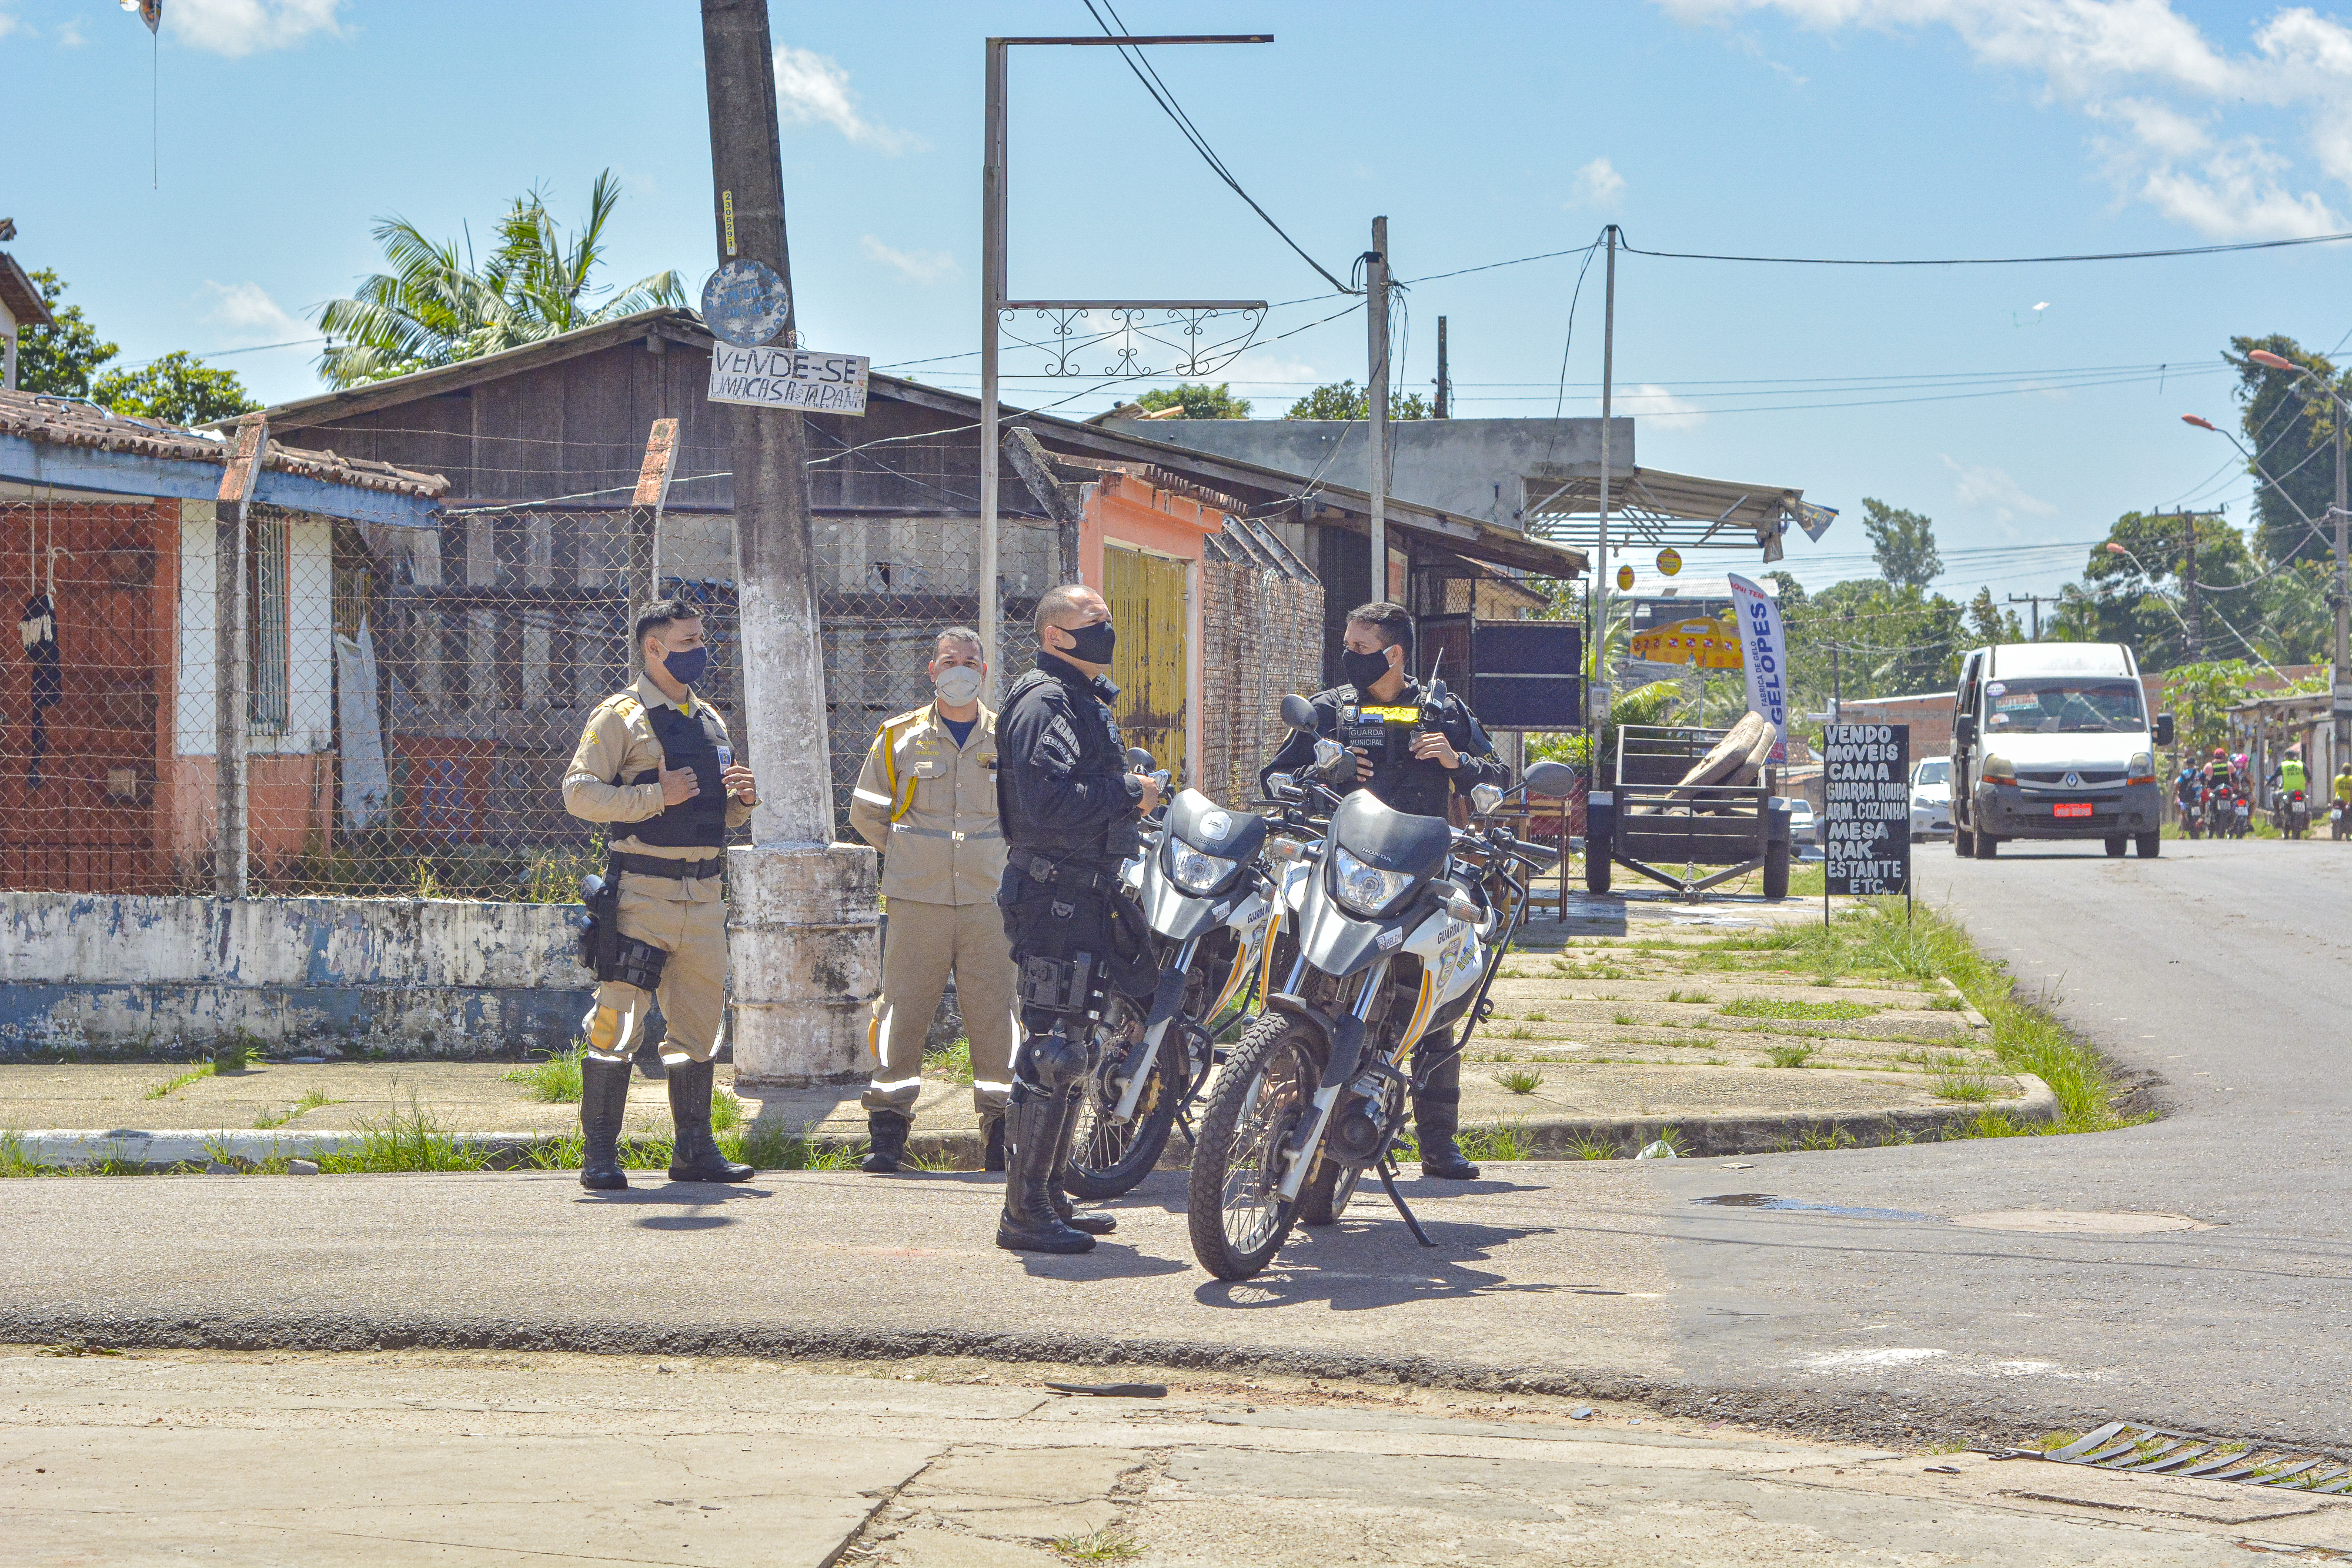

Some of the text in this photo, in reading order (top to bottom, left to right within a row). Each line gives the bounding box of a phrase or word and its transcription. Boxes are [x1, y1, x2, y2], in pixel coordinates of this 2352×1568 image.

[716, 347, 857, 383] VENDE-SE
[1749, 590, 1764, 600] TEM
[1750, 641, 1760, 661] GELO
[1750, 602, 1783, 726] GELOPES
[1755, 663, 1762, 673] DE
[1825, 726, 1892, 744] VENDO
[1825, 744, 1898, 762] MOVEIS
[1828, 763, 1889, 781] CAMA
[1826, 783, 1908, 802] GUARDA ROUPA
[1828, 822, 1889, 840] MESA
[1194, 837, 1219, 850] HONDA
[1829, 840, 1873, 861] RAK
[1361, 847, 1392, 862] HONDA
[1828, 860, 1902, 878] ESTANTE
[1248, 907, 1265, 924] GUARDA
[1438, 922, 1459, 944] GUARDA
